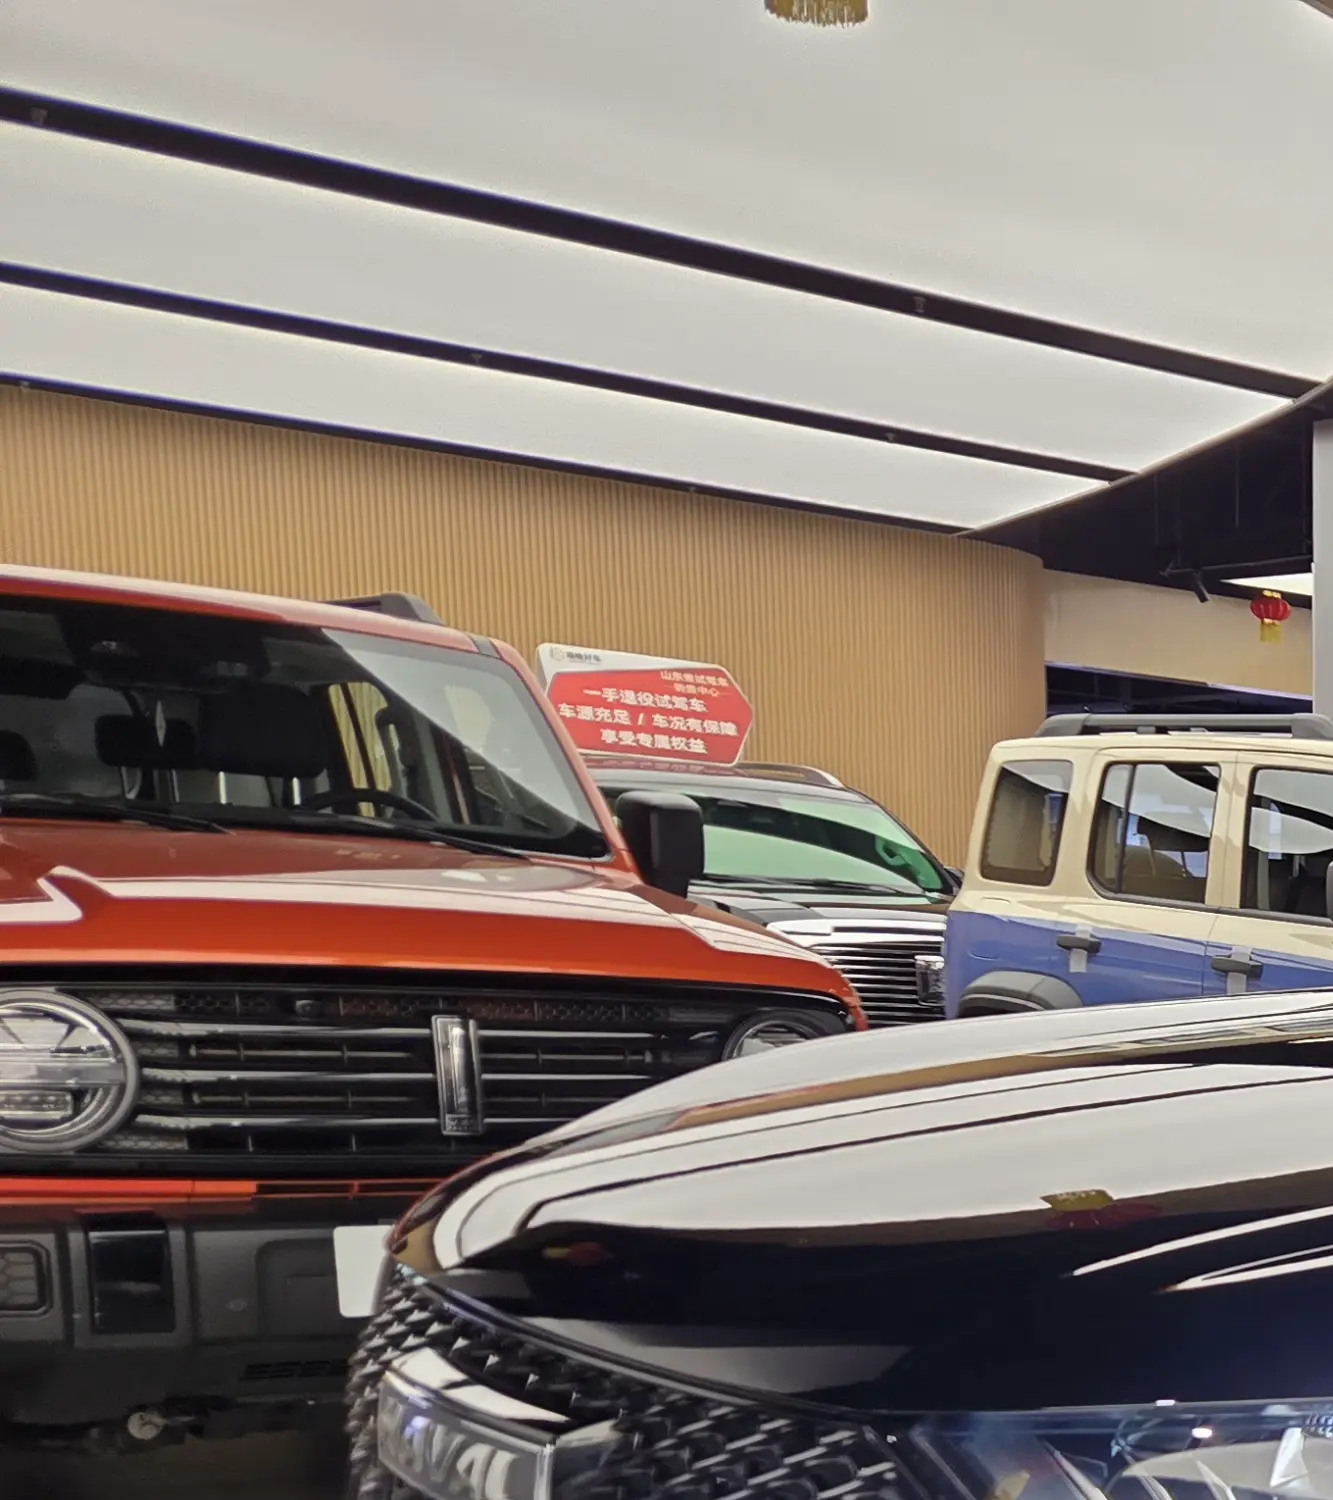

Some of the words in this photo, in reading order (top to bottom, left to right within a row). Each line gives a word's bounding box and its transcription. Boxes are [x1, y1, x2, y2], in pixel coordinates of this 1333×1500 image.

[583, 687, 708, 713] 一手退役试驾车
[557, 703, 632, 726] 车源充足
[652, 713, 740, 737] 车况有保障
[600, 728, 708, 754] 享受专属权益
